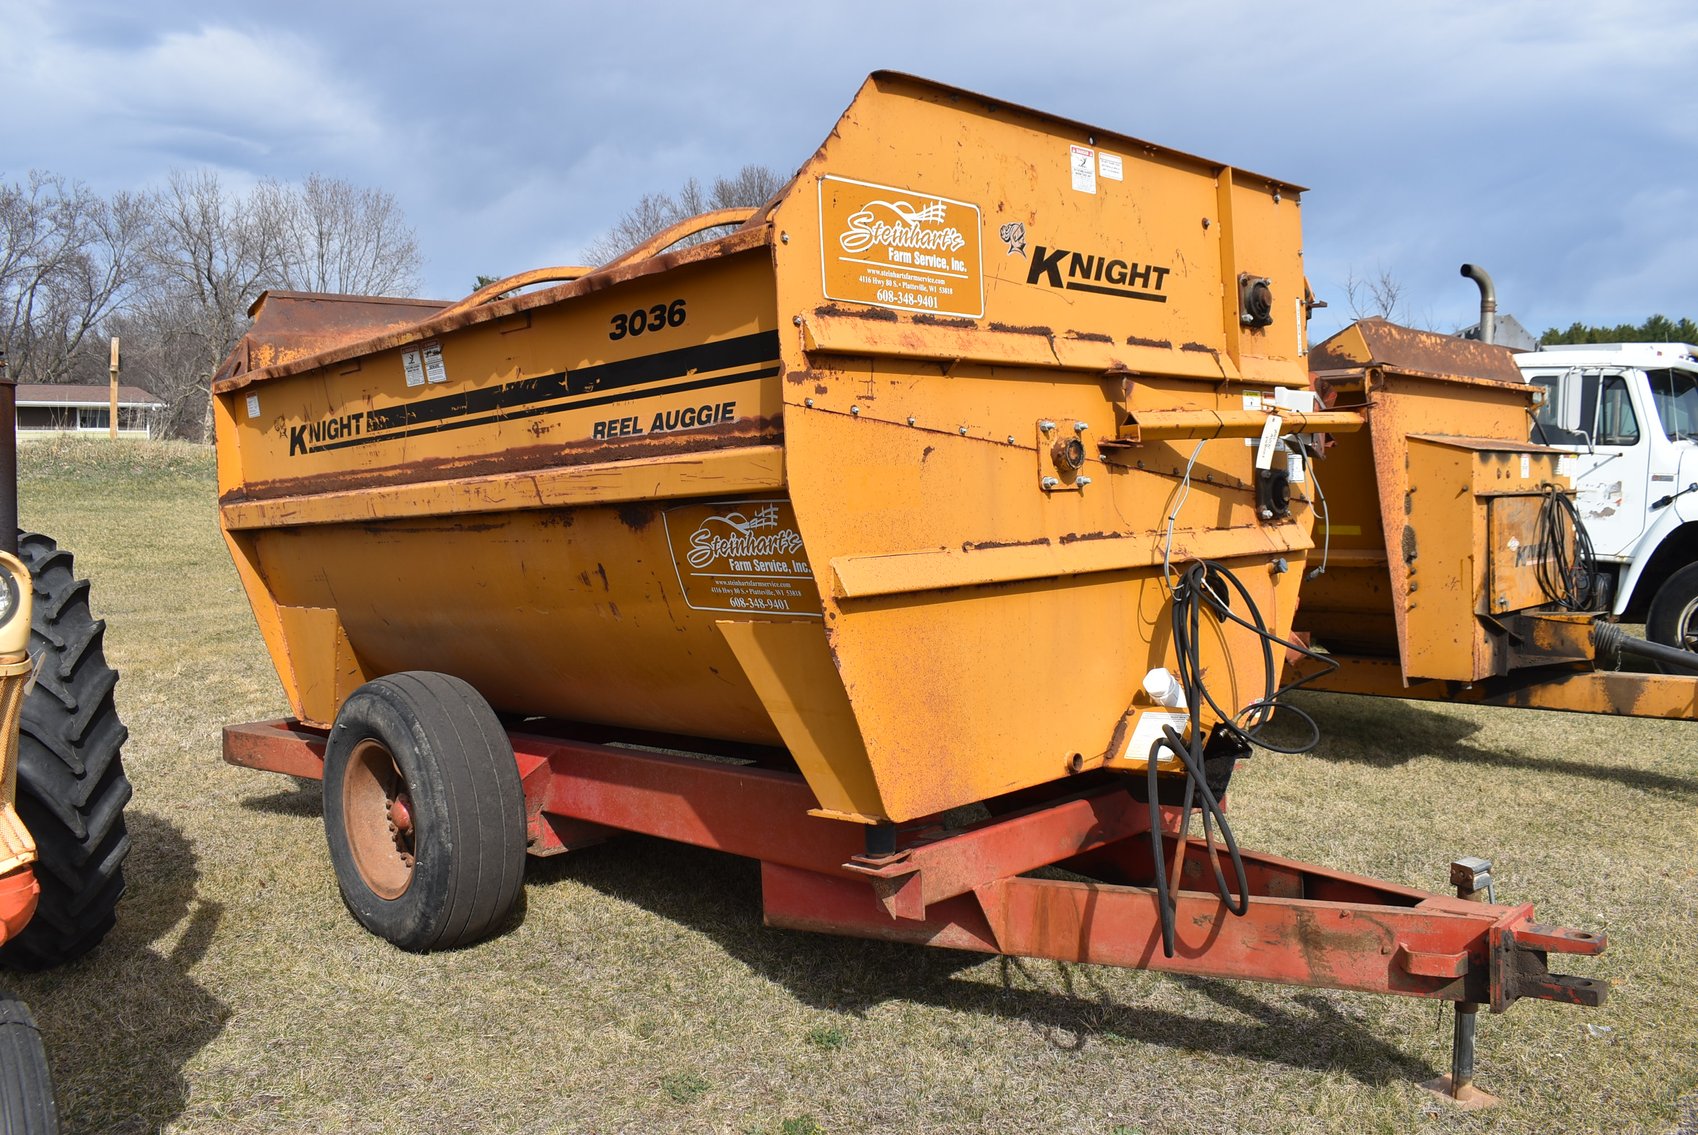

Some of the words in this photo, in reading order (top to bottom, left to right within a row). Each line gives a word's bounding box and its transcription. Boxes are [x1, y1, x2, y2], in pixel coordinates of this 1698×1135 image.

[839, 212, 965, 253] Steinhart's
[888, 247, 912, 264] Farm
[914, 251, 950, 271] Service,
[951, 259, 968, 272] Inc.
[1026, 245, 1170, 291] KNIGHT
[859, 275, 872, 284] 4116
[872, 277, 885, 287] Hwy
[876, 288, 938, 308] 608-348-9401
[609, 299, 686, 341] 3036
[289, 412, 364, 457] KNIGHT
[593, 416, 643, 440] REEL
[650, 401, 736, 432] AUGGIE
[686, 528, 803, 569] Steinhart's
[728, 558, 753, 572] Farm
[753, 558, 792, 574] Service,
[792, 560, 811, 573] Inc.
[729, 596, 790, 610] 608-348-9401
